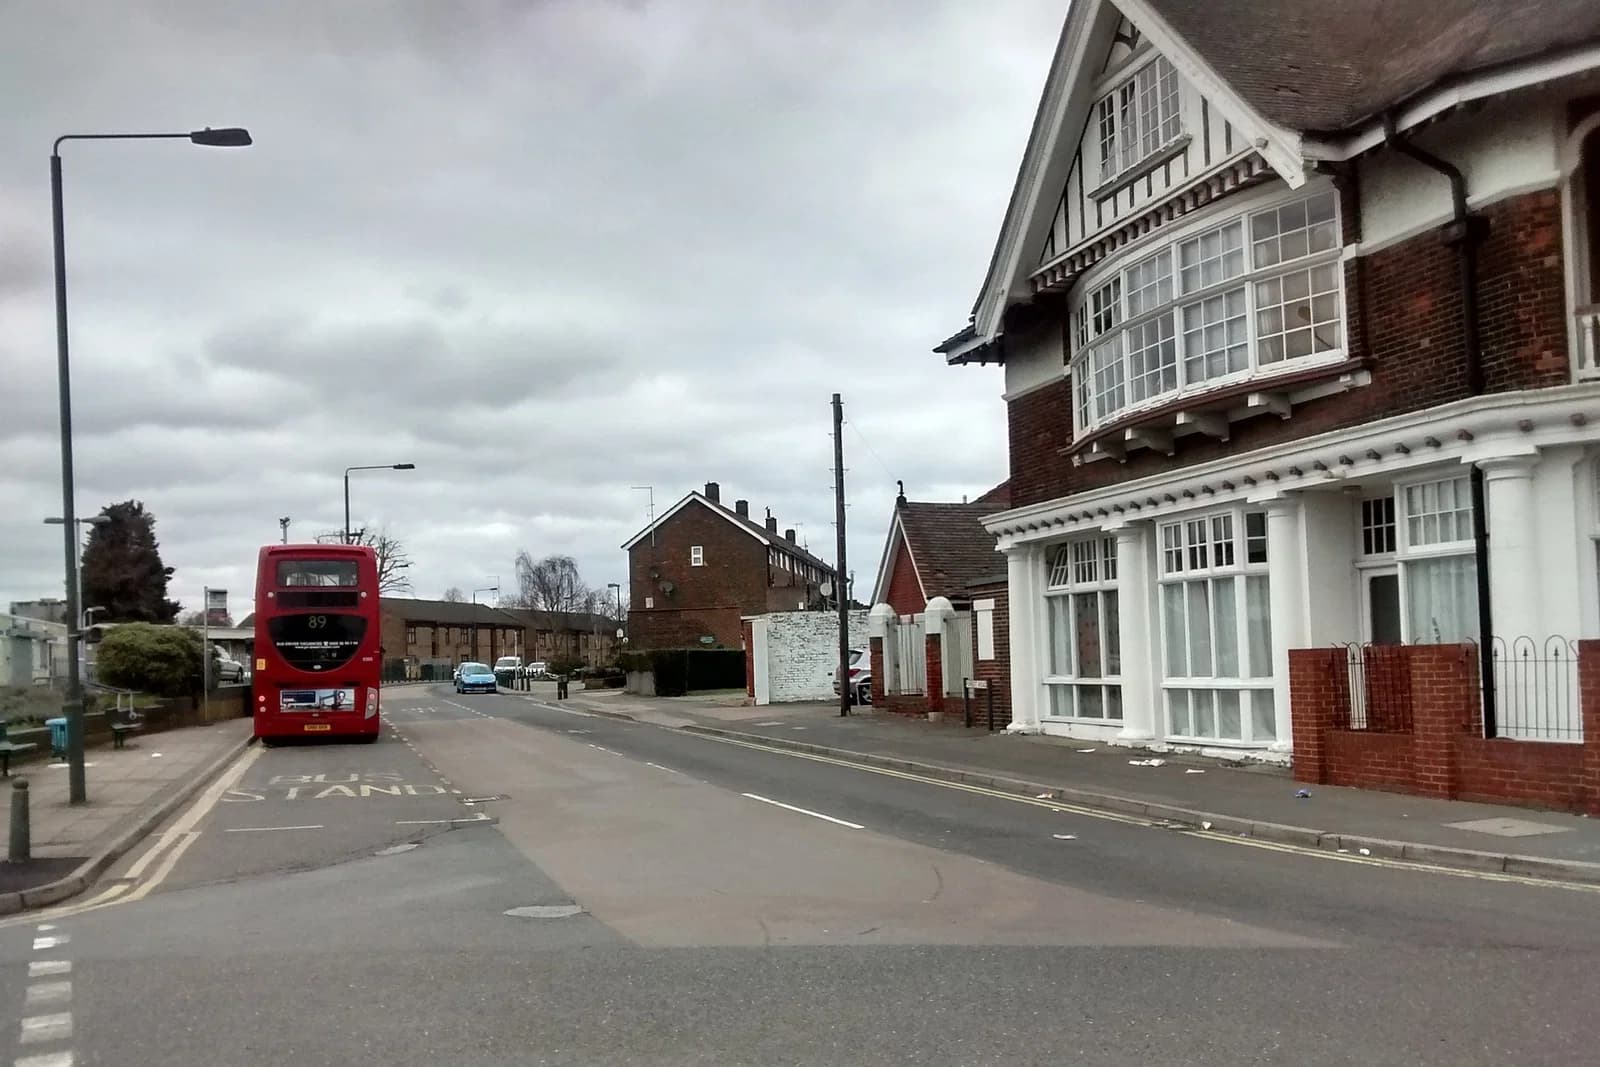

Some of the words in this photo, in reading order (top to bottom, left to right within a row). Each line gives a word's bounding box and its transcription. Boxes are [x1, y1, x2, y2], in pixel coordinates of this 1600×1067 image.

[308, 615, 327, 629] 89
[268, 772, 405, 785] BUS
[219, 784, 447, 802] STAND
